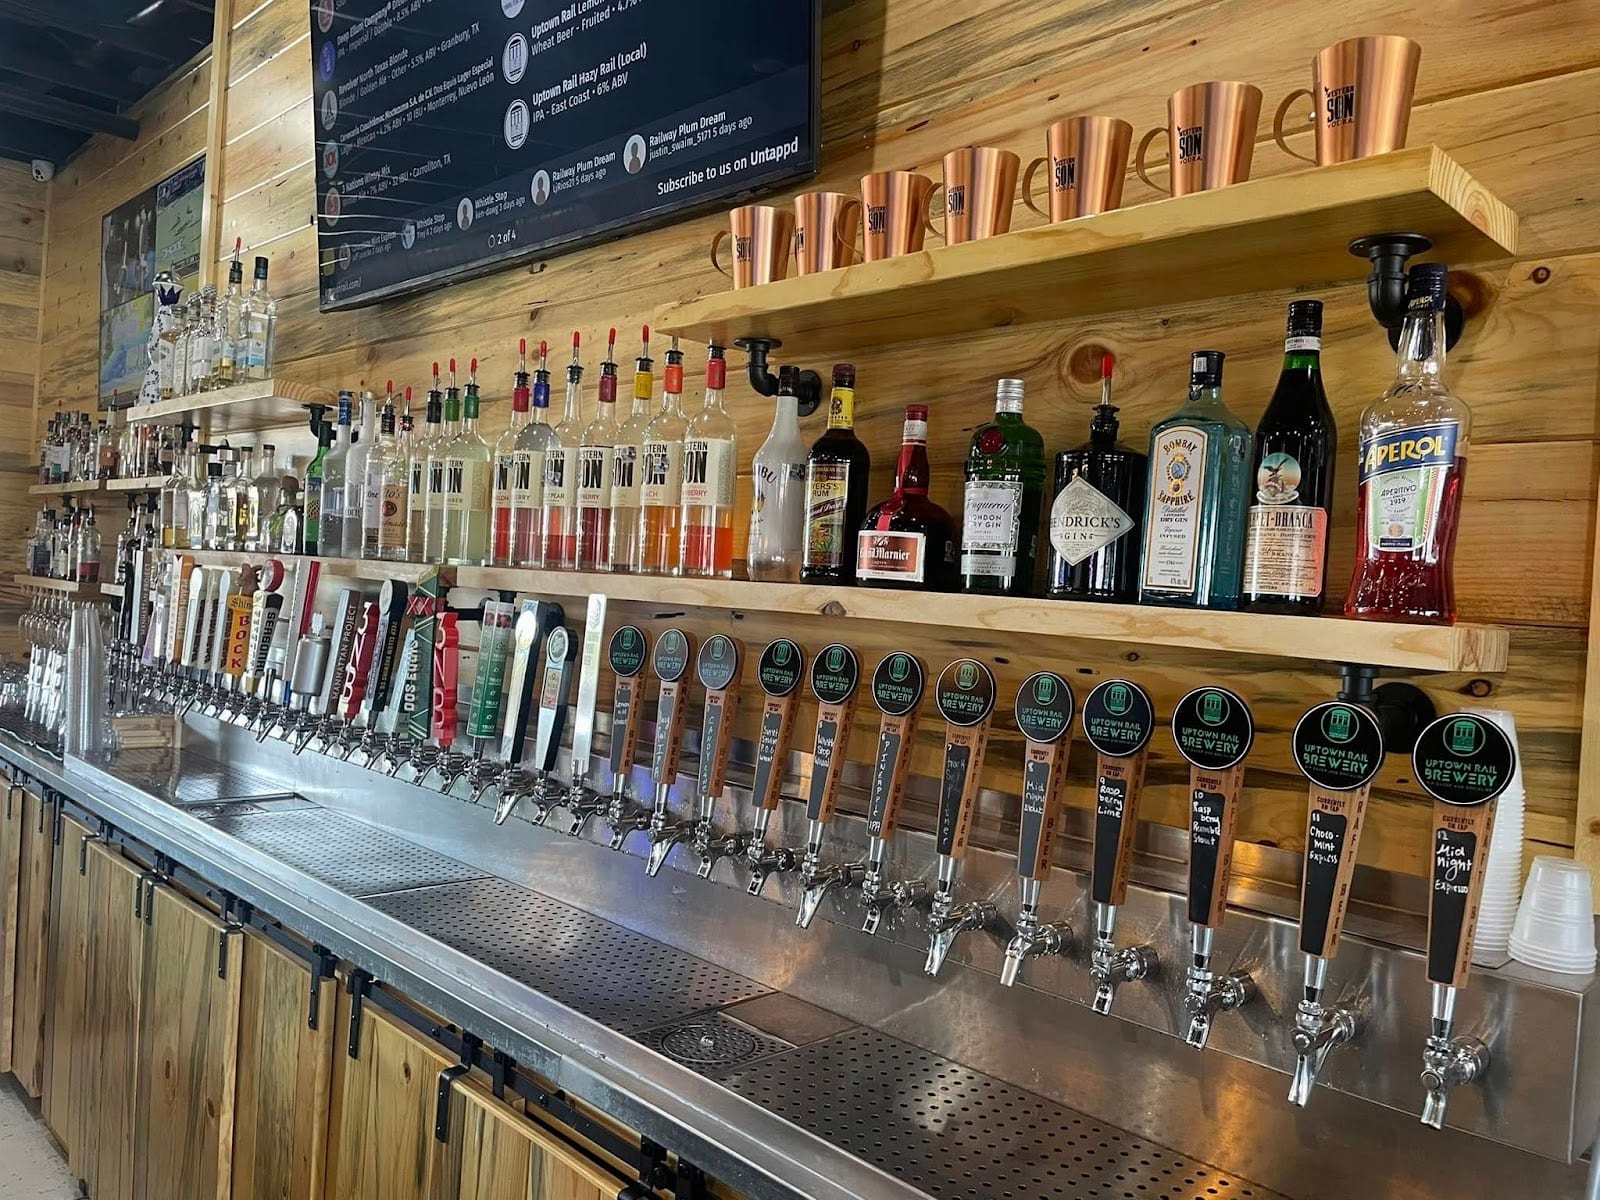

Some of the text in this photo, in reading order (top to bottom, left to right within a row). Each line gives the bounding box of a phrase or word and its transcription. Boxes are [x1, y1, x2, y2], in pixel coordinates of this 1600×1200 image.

[531, 8, 576, 39] Uptown Rail
[531, 6, 610, 56] Wheat Beer Fruited
[425, 47, 436, 62] ABV
[471, 22, 480, 35] TX
[471, 56, 494, 75] Especial
[532, 41, 647, 106] Uptown Rail Hazy Rail (Local)
[458, 83, 477, 98] Nuevo
[479, 71, 495, 88] León
[1327, 85, 1354, 98] WESTERN
[533, 72, 629, 123] IPA East Coast 6% ABV
[1327, 93, 1354, 122] SON
[649, 111, 726, 147] Railway Plum Dream
[712, 127, 718, 137] 5
[719, 121, 736, 136] days
[738, 115, 753, 129] ago
[1179, 133, 1202, 159] SON
[444, 153, 451, 164] TX
[552, 151, 616, 182] Railway Plum Dream
[657, 136, 799, 196] Subscribe to us on Untappd
[580, 172, 594, 184] days
[595, 168, 607, 180] ago
[1055, 164, 1075, 187] SON
[495, 191, 508, 202] Stop
[516, 196, 526, 208] ago
[948, 192, 965, 213] SON
[868, 212, 885, 231] SON
[498, 230, 517, 244] 2 of 4
[1163, 439, 1198, 456] BOMBAY
[1364, 435, 1446, 473] APEROL
[685, 451, 708, 483] ON
[1157, 490, 1196, 506] SAPPHIRE
[1381, 484, 1416, 497] APERITIVO
[231, 616, 250, 668] BOCK
[255, 611, 276, 677] SEASONAL
[332, 605, 357, 700] MANHATTAN PROJECT
[612, 657, 639, 666] BREWERY
[762, 673, 793, 685] BREWERY
[816, 681, 848, 691] BREWERY
[877, 690, 913, 701] BREWERY
[943, 691, 970, 700] UPTOWN
[942, 699, 984, 714] BREWERY
[1022, 707, 1064, 718] UPTOWN RAIL
[1021, 714, 1063, 728] BREWERY
[1091, 717, 1141, 731] UPTOWN RAIL
[1090, 726, 1141, 741] BREWERY
[1182, 726, 1239, 743] UPTOWN RAIL
[1182, 736, 1239, 755] BREWERY
[1304, 744, 1369, 763] UPTOWN RAIL
[1303, 754, 1368, 775] BREWERY
[1426, 759, 1498, 774] UPTOWN RAIL
[1424, 768, 1498, 787] BREWERY
[1194, 791, 1204, 799] 10
[1098, 806, 1121, 818] Lime
[1436, 844, 1465, 857] Mid
